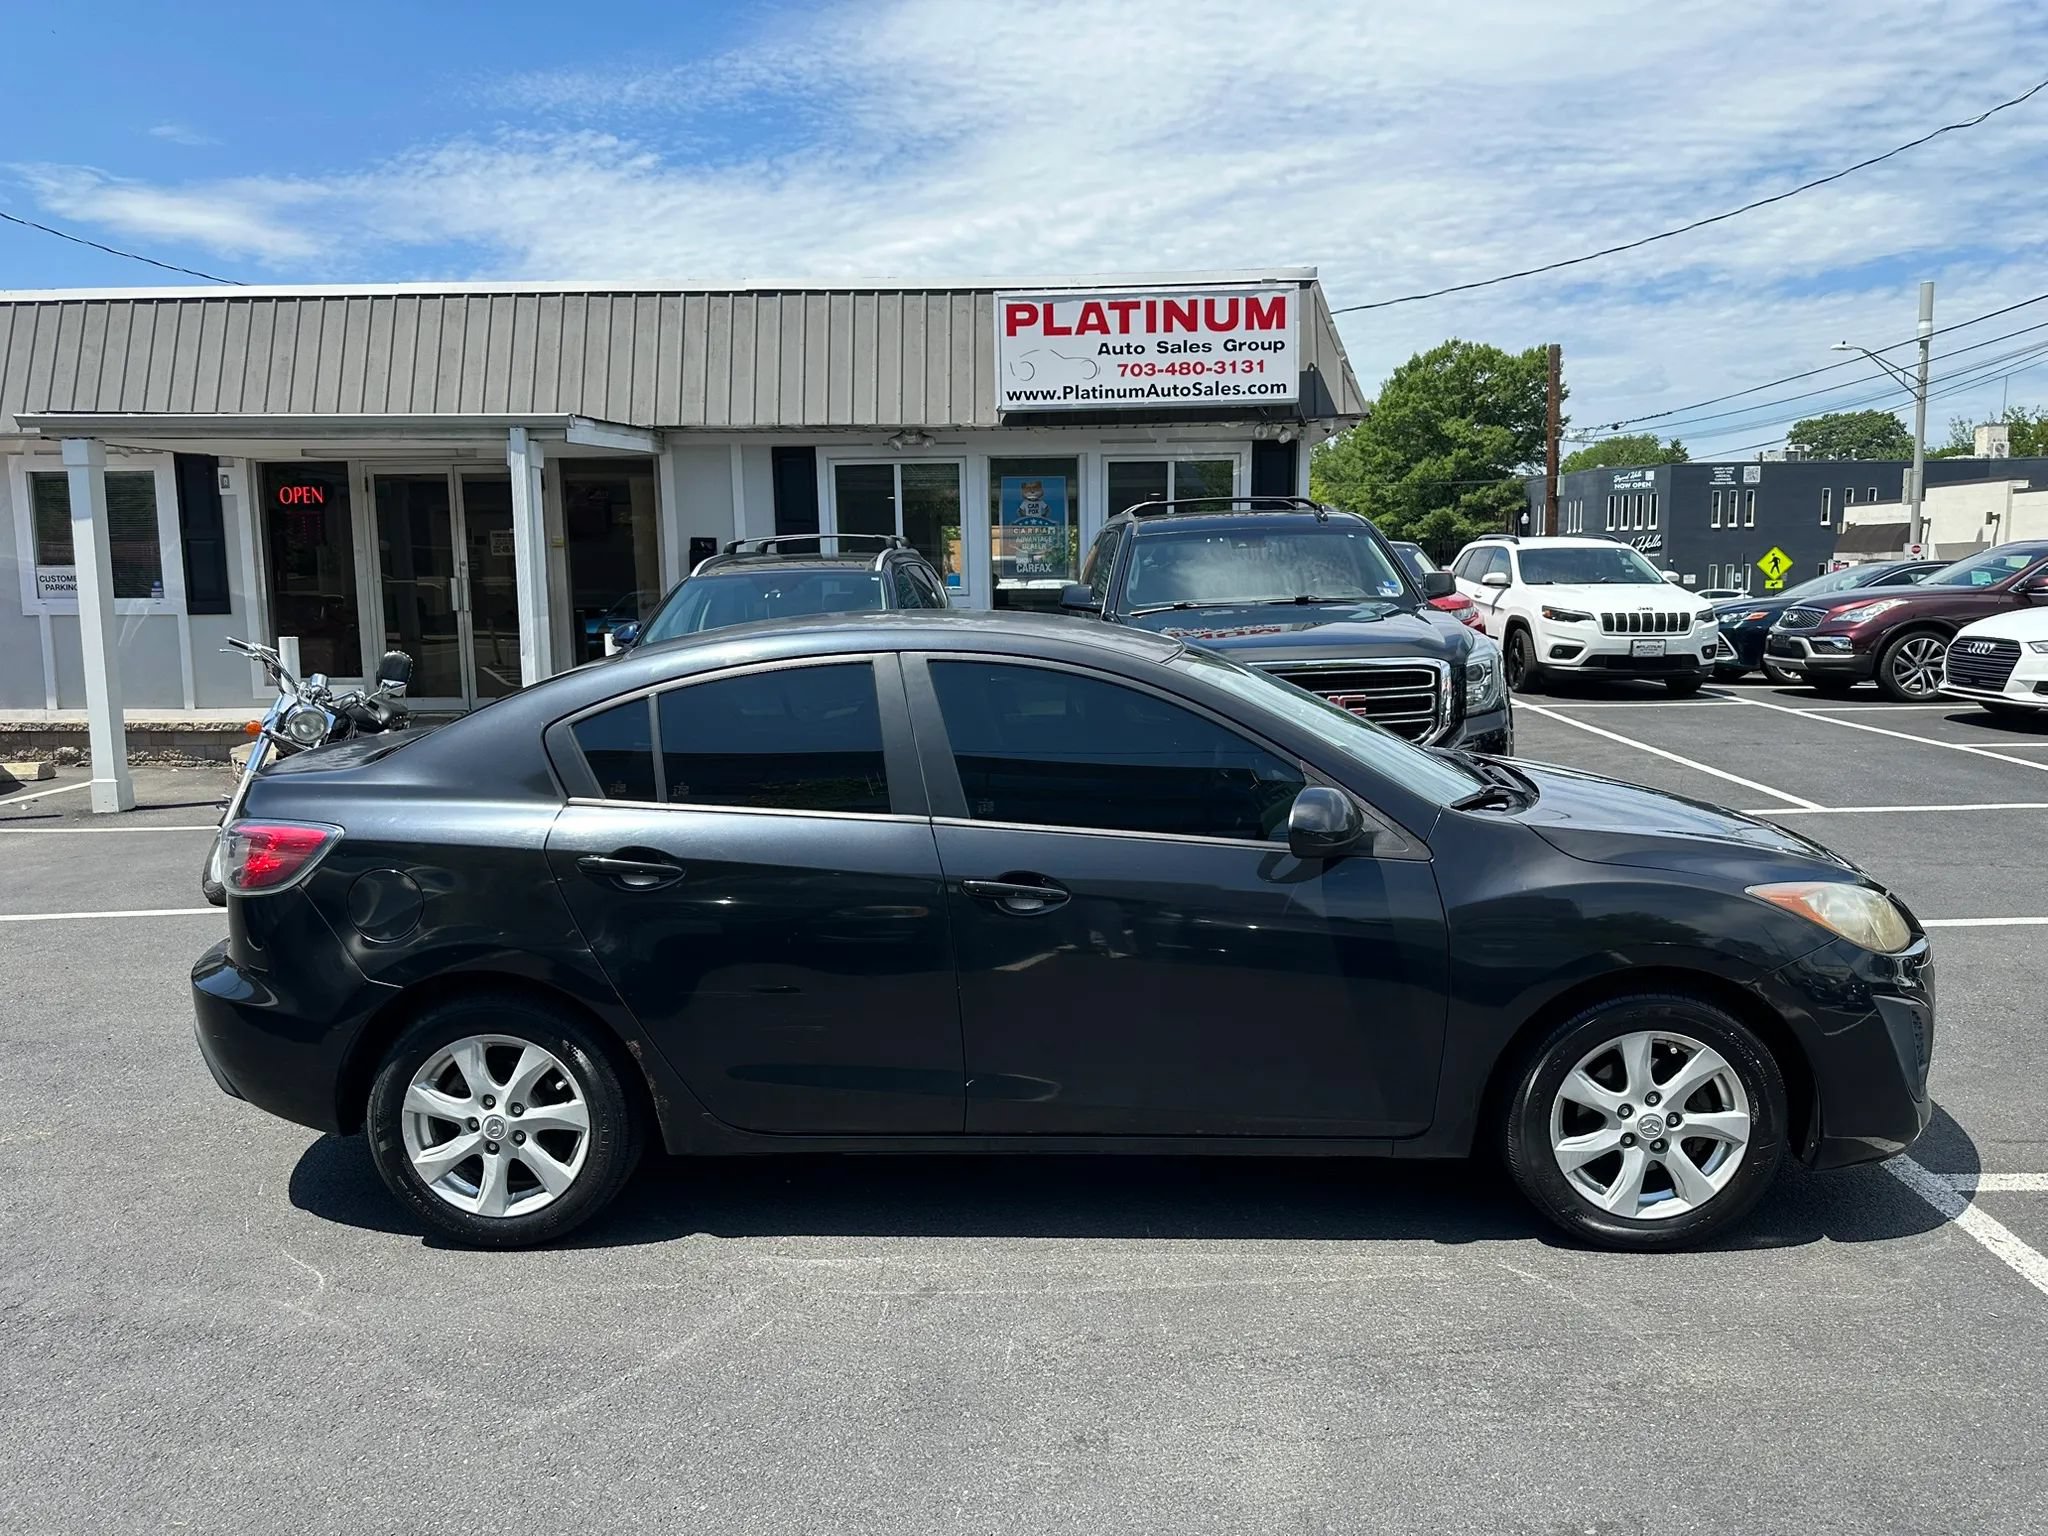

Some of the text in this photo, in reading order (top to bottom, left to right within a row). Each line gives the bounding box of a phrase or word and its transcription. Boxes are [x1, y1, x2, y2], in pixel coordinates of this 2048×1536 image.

[1006, 296, 1287, 337] PLATINUM
[1097, 338, 1285, 356] Auto Sales Group
[1117, 359, 1265, 378] 703-480-3131
[1006, 381, 1288, 402] www.PlatinumAutoSales.com
[279, 486, 324, 504] OPEN
[1635, 534, 1662, 551] Hello
[1016, 563, 1052, 573] CARFAX
[39, 575, 77, 583] CUSTOME
